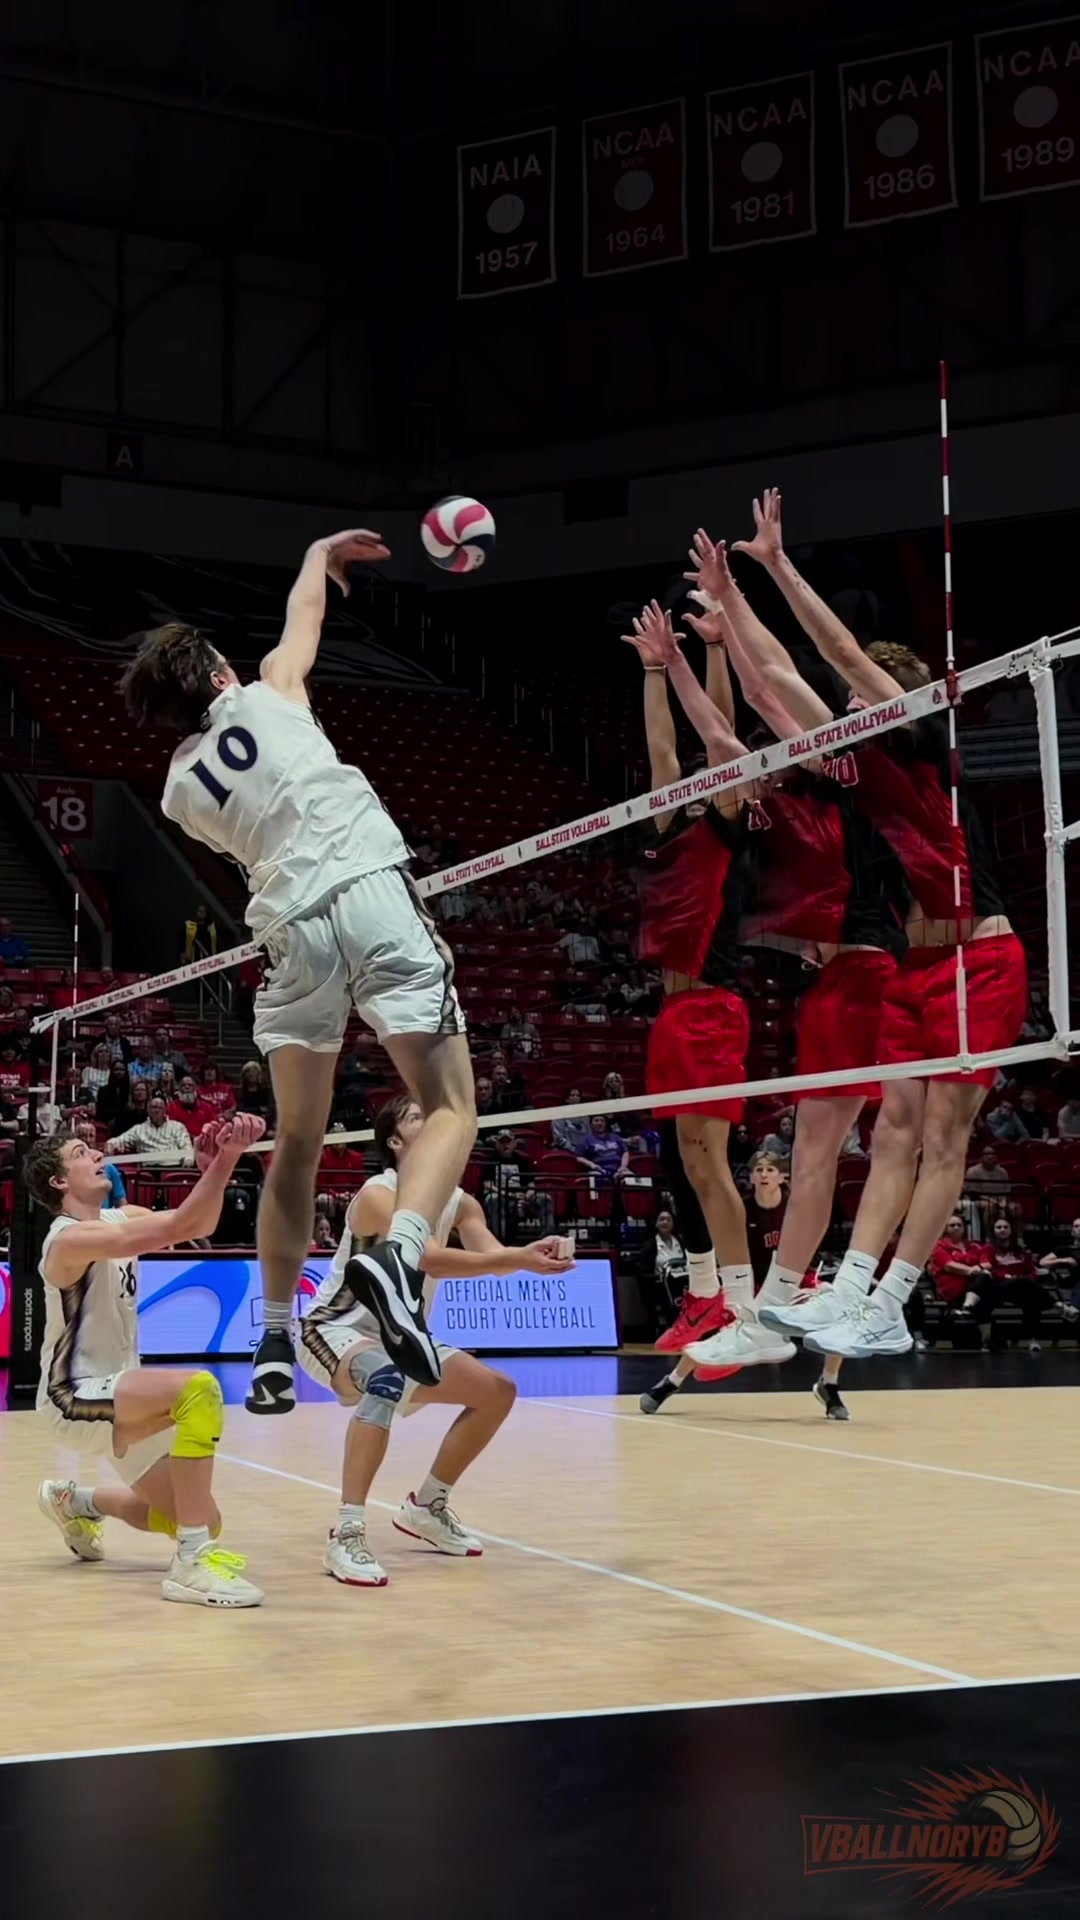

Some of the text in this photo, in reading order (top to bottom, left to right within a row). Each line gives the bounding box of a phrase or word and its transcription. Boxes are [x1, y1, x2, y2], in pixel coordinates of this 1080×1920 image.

[983, 40, 1080, 83] NCAA
[847, 69, 944, 111] NCAA
[713, 98, 807, 138] NCAA
[592, 121, 675, 160] NCAA
[1001, 137, 1075, 173] 1989
[470, 153, 542, 189] NAIA
[863, 164, 935, 200] 1986
[730, 191, 794, 224] 1981
[605, 224, 666, 254] 1964
[475, 241, 538, 274] 1957
[115, 445, 134, 469] A
[789, 702, 908, 758] BALL STATE VOLLEYBALL
[185, 725, 258, 811] 10
[649, 765, 743, 810] BALL STATE VOLLEYBALL
[41, 796, 87, 832] 18
[571, 815, 610, 838] VOLLEYBALL
[445, 1279, 566, 1302] OFFICIAL MEN'S
[446, 1306, 596, 1329] COURT VOLLEYBALL
